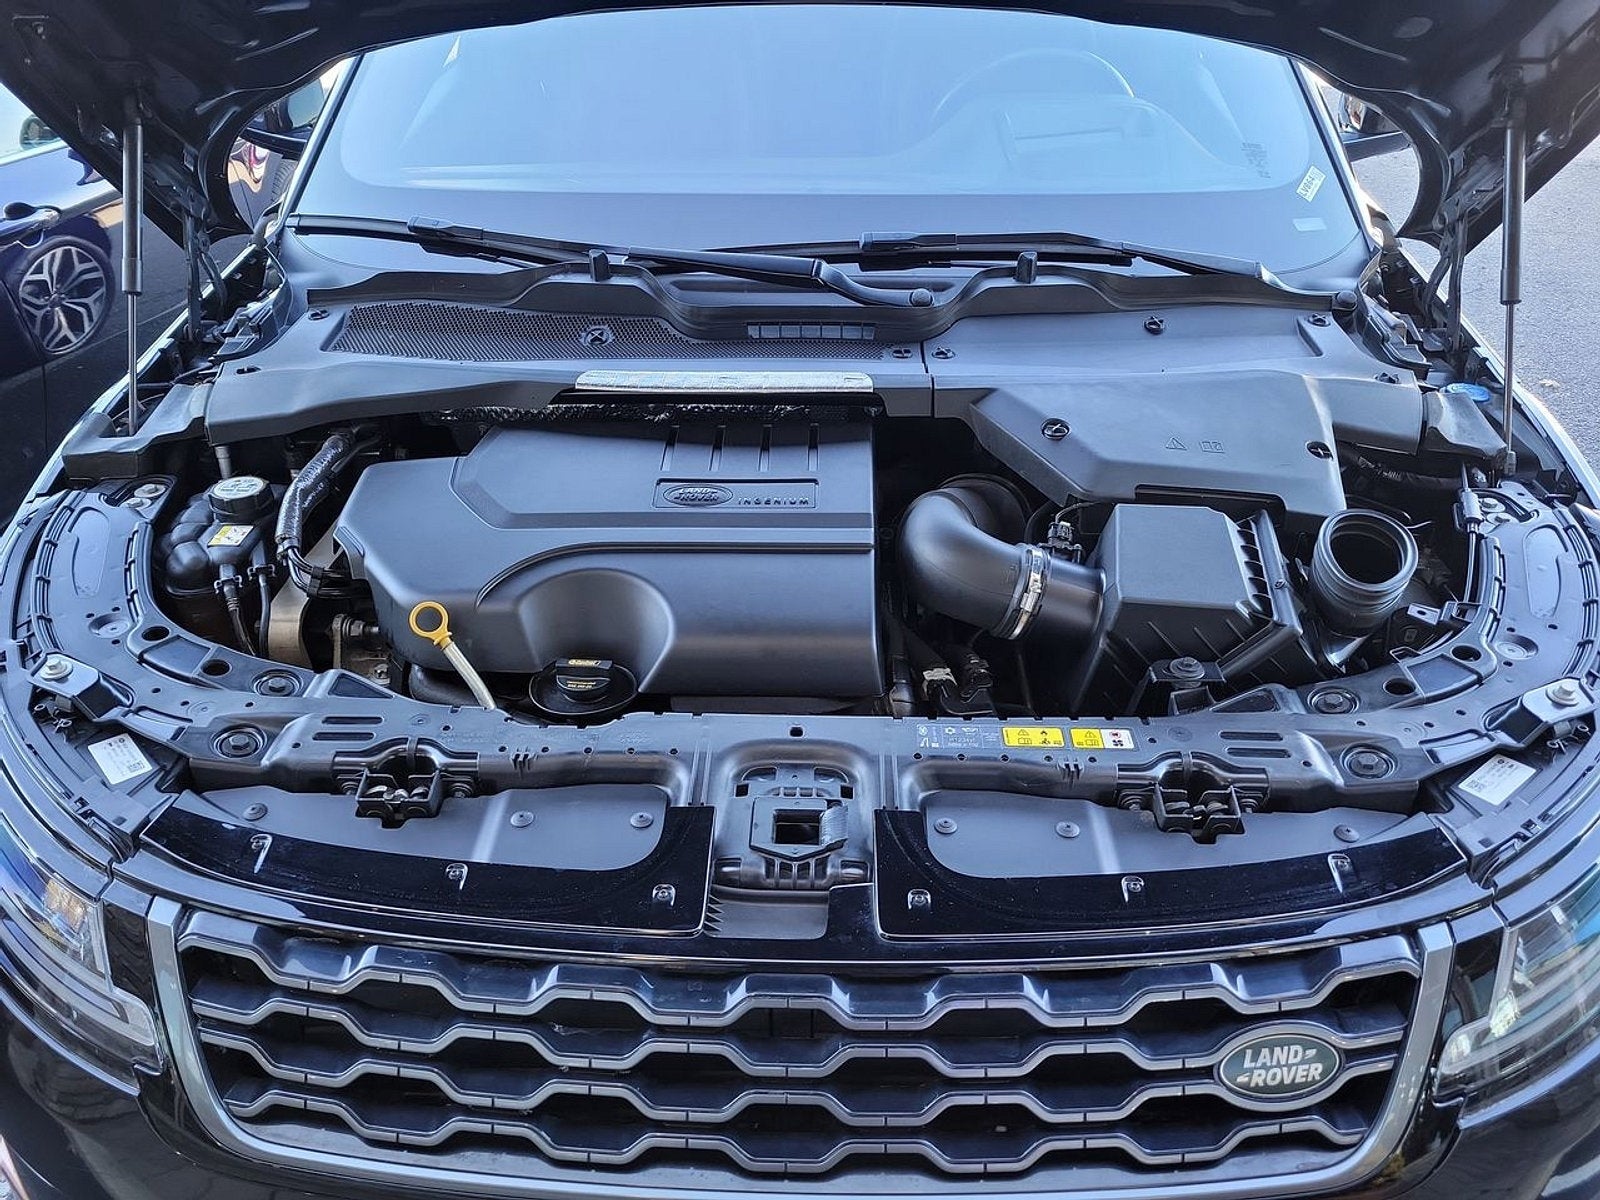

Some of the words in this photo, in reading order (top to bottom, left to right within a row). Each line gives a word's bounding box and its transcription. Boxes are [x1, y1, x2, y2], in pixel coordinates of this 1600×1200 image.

[680, 493, 720, 502] ROVER
[738, 497, 809, 505] INGENIUM
[1243, 1045, 1303, 1068] LAND
[1249, 1063, 1323, 1087] ROVER
